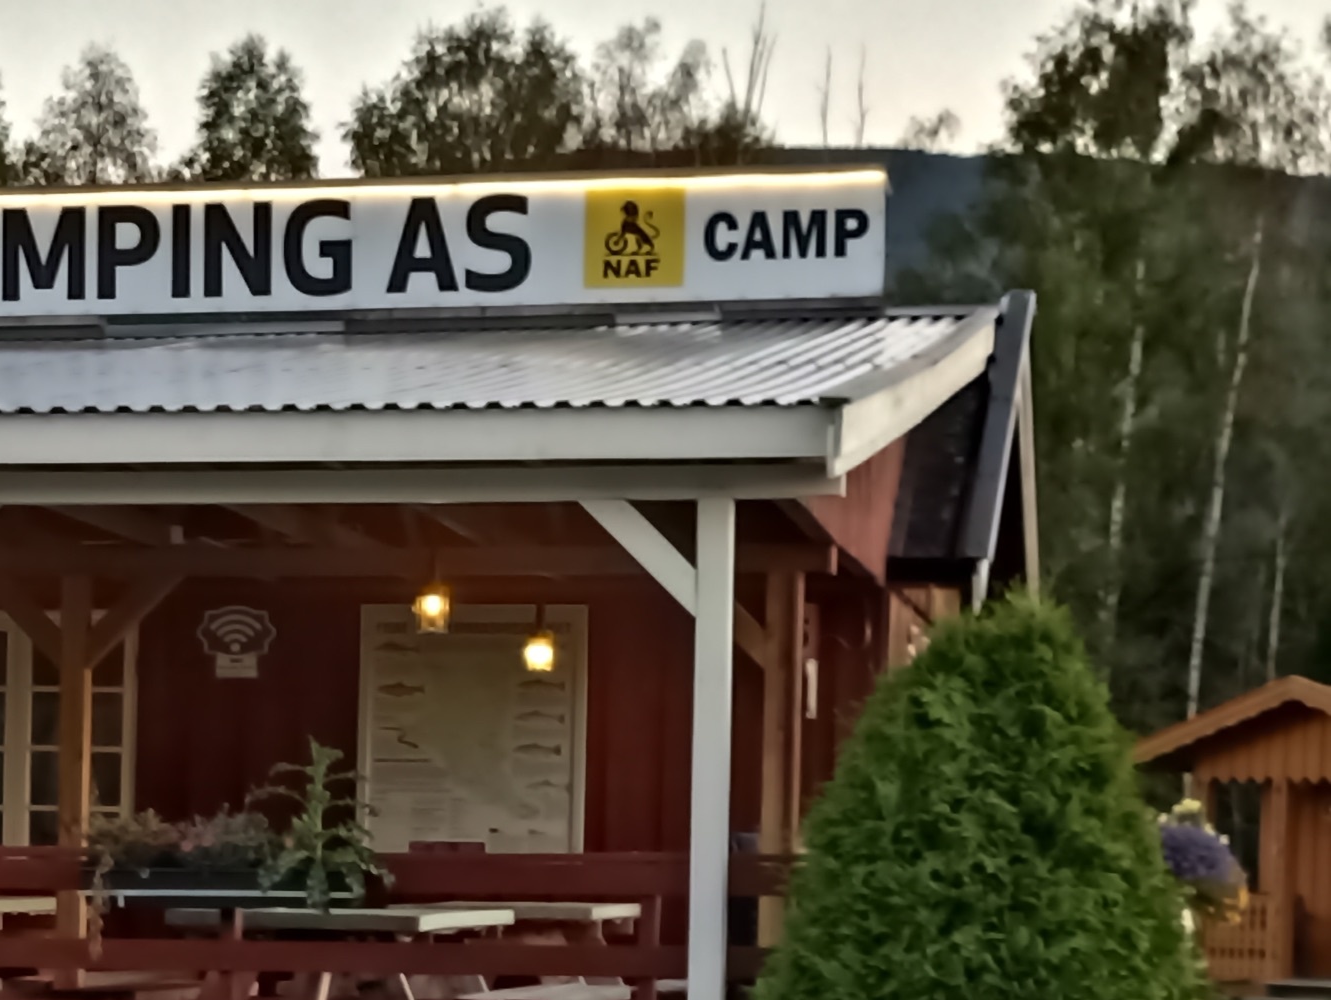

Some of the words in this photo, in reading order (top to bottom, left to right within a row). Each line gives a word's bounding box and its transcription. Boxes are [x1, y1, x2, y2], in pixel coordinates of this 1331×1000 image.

[387, 193, 533, 295] AS
[703, 207, 872, 262] CAMP
[602, 257, 661, 279] NAF
